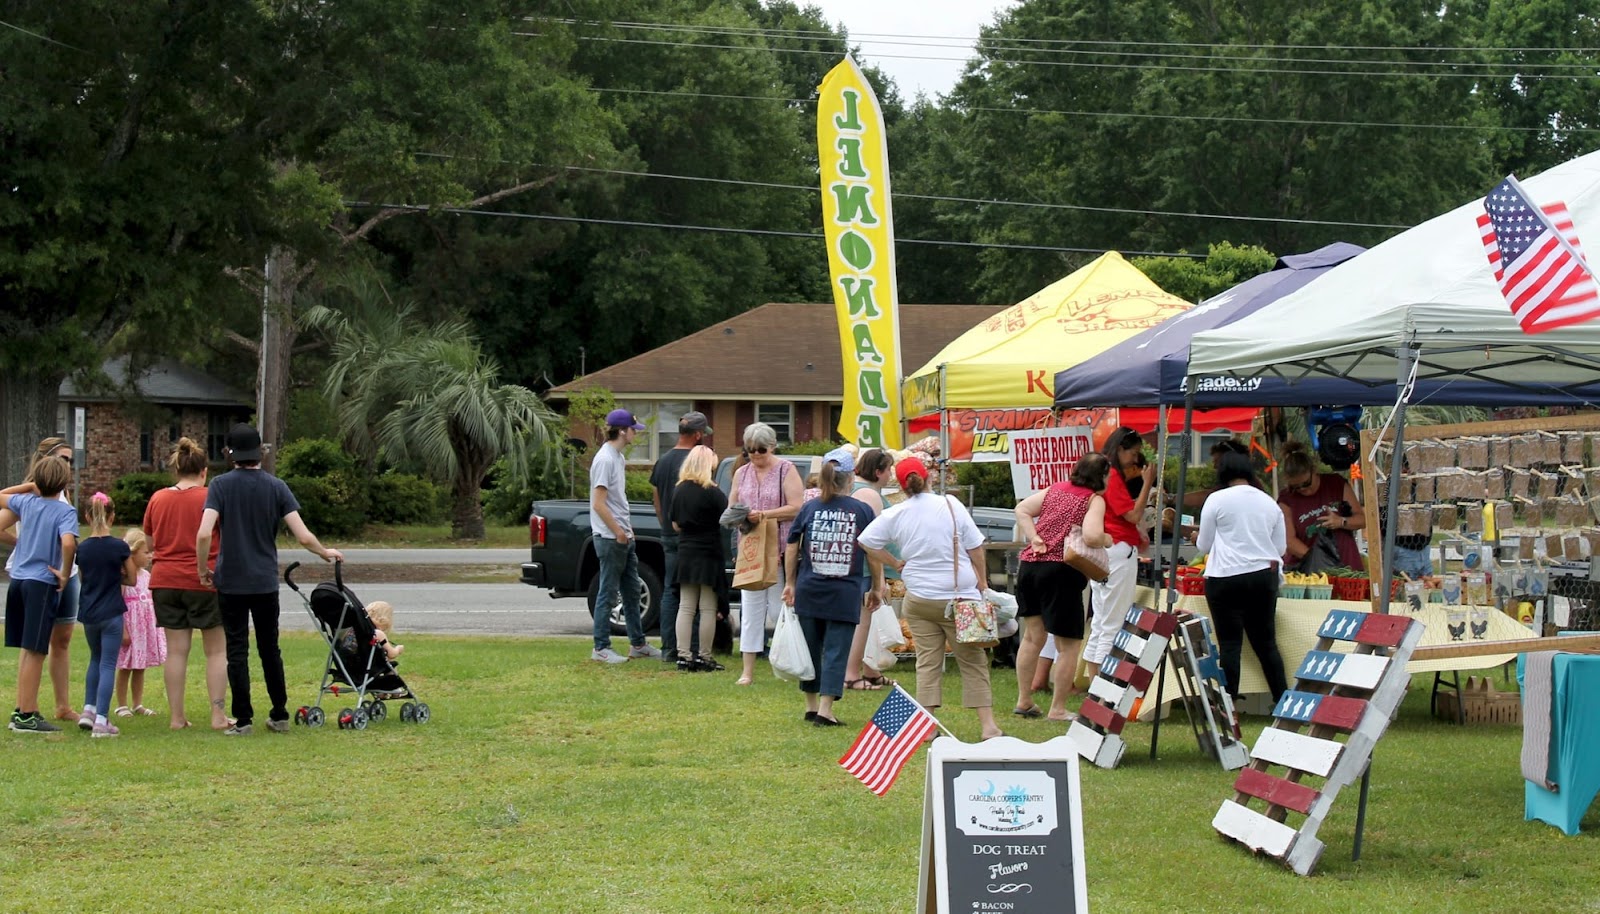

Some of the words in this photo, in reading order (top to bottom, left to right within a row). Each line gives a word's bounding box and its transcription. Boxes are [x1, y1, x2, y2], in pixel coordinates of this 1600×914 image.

[1014, 437, 1050, 464] FRESH
[1051, 435, 1090, 463] BOILED
[1029, 463, 1077, 490] PEANUT
[814, 510, 856, 522] FAMILY
[812, 520, 856, 533] FAITH
[811, 531, 854, 543] FRIENDS
[810, 541, 853, 554] FLAG
[810, 552, 852, 562] FIREARMS
[973, 844, 1001, 855] DOG
[1005, 845, 1047, 855] TREAT
[988, 861, 1028, 879] Flavors
[981, 902, 1014, 910] BACON
